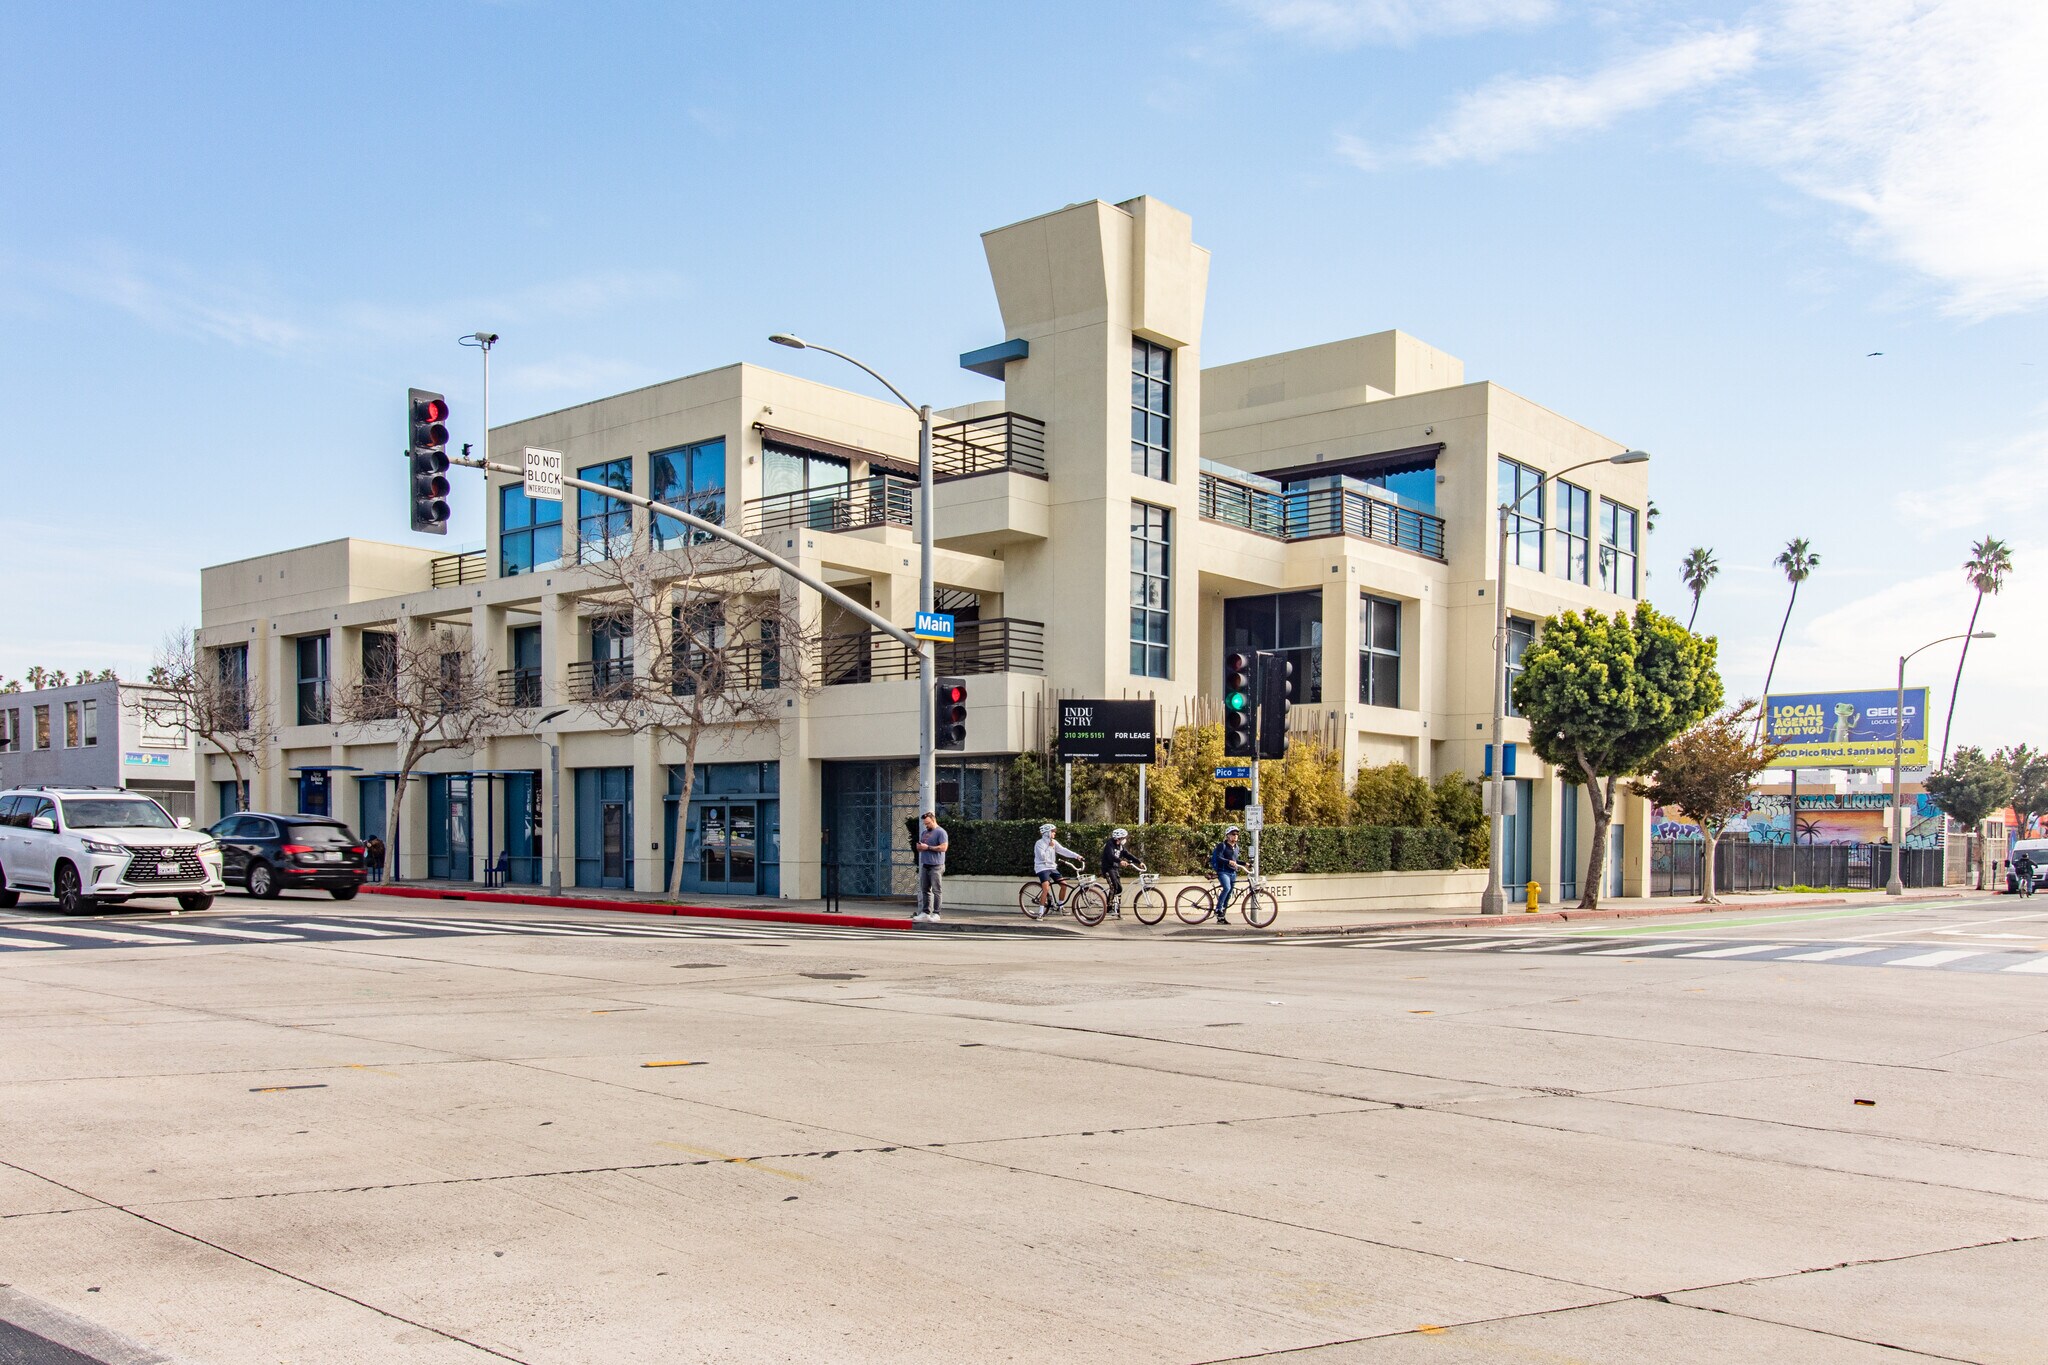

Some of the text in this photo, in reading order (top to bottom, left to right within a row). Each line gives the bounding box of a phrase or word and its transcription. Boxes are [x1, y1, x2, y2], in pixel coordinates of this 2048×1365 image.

[527, 453, 560, 468] DO NOT
[527, 469, 561, 485] BLOCK
[528, 484, 561, 495] INTERSECTION
[918, 614, 951, 632] Main
[1064, 707, 1093, 717] INDU
[1773, 704, 1824, 718] LOCAL
[1064, 716, 1093, 726] STRY
[1774, 716, 1824, 728] AGENTS
[1773, 726, 1824, 736] NEAR YOU
[1774, 749, 1798, 757] 020
[1798, 749, 1820, 757] Pico
[1821, 748, 1846, 757] Blvd.
[1847, 748, 1876, 756] Santa
[1216, 768, 1232, 776] Pico
[1797, 794, 1840, 809] STAR
[1842, 793, 1894, 809] LIQUOR
